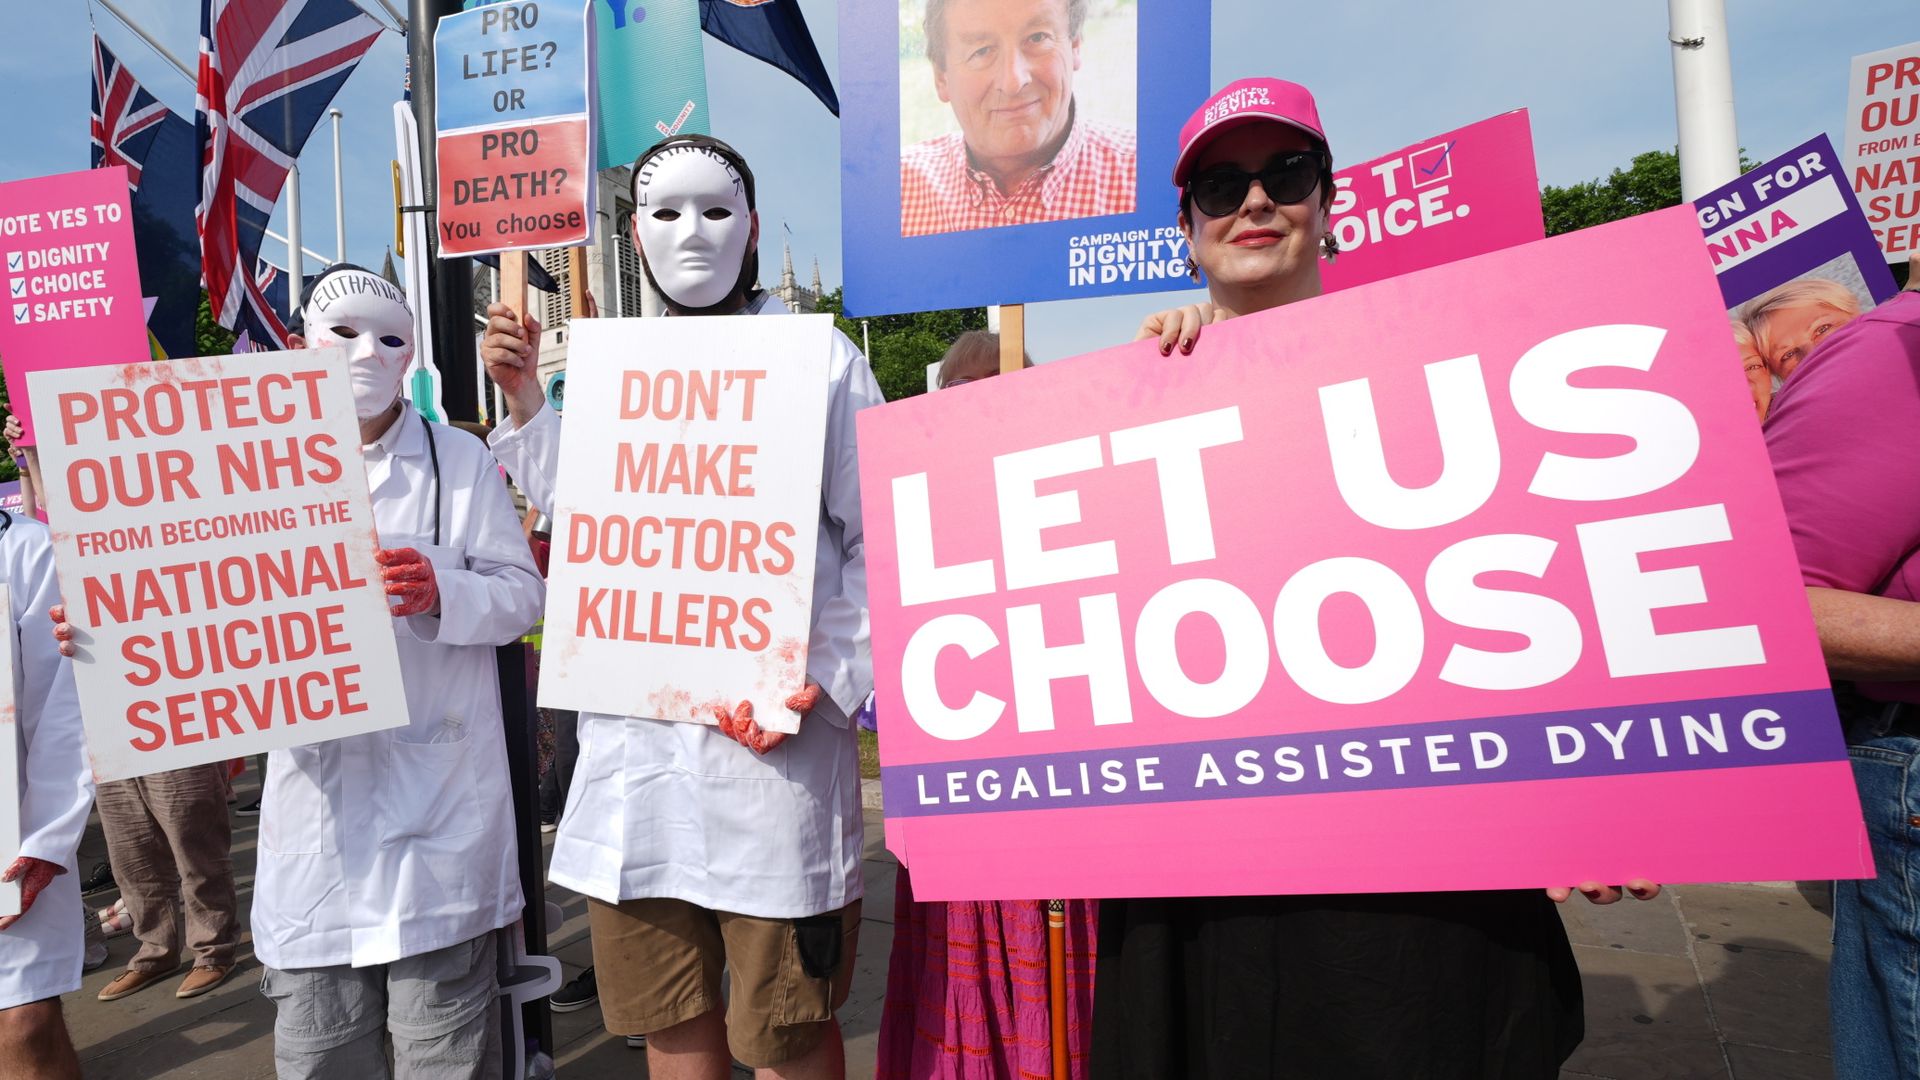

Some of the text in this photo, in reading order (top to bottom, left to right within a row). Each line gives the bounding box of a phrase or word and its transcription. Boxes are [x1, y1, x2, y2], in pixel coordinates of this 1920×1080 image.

[481, 3, 539, 35] PRO
[463, 42, 558, 80] LIFE?
[493, 88, 526, 113] OR
[481, 129, 539, 160] PRO
[1858, 135, 1908, 157] FROM
[453, 168, 568, 206] DEATH?
[1752, 151, 1827, 202] FOR
[47, 207, 88, 230] YES
[93, 203, 122, 224] TO
[442, 209, 581, 241] You choose
[1069, 229, 1149, 248] CAMPAIGN
[27, 242, 110, 269] DIGNITY
[1069, 238, 1185, 268] DIGNITY
[1069, 258, 1191, 286] IN DYING.
[31, 269, 106, 295] CHOICE
[34, 296, 114, 322] SAFETY
[57, 369, 328, 446] PROTECT
[618, 369, 766, 421] DON’T
[66, 433, 343, 513] OUR NHS
[613, 442, 758, 497] MAKE
[891, 323, 1700, 606] LET US
[76, 500, 353, 557] FROM BECOMING THE
[566, 513, 796, 576] DOCTORS
[82, 542, 367, 628] NATIONAL
[575, 586, 773, 652] KILLERS
[901, 503, 1767, 741] CHOOSE
[120, 604, 352, 687] SUICIDE
[126, 664, 369, 753] SERVICE
[916, 708, 1786, 805] LEGALISE ASSISTED DYING
